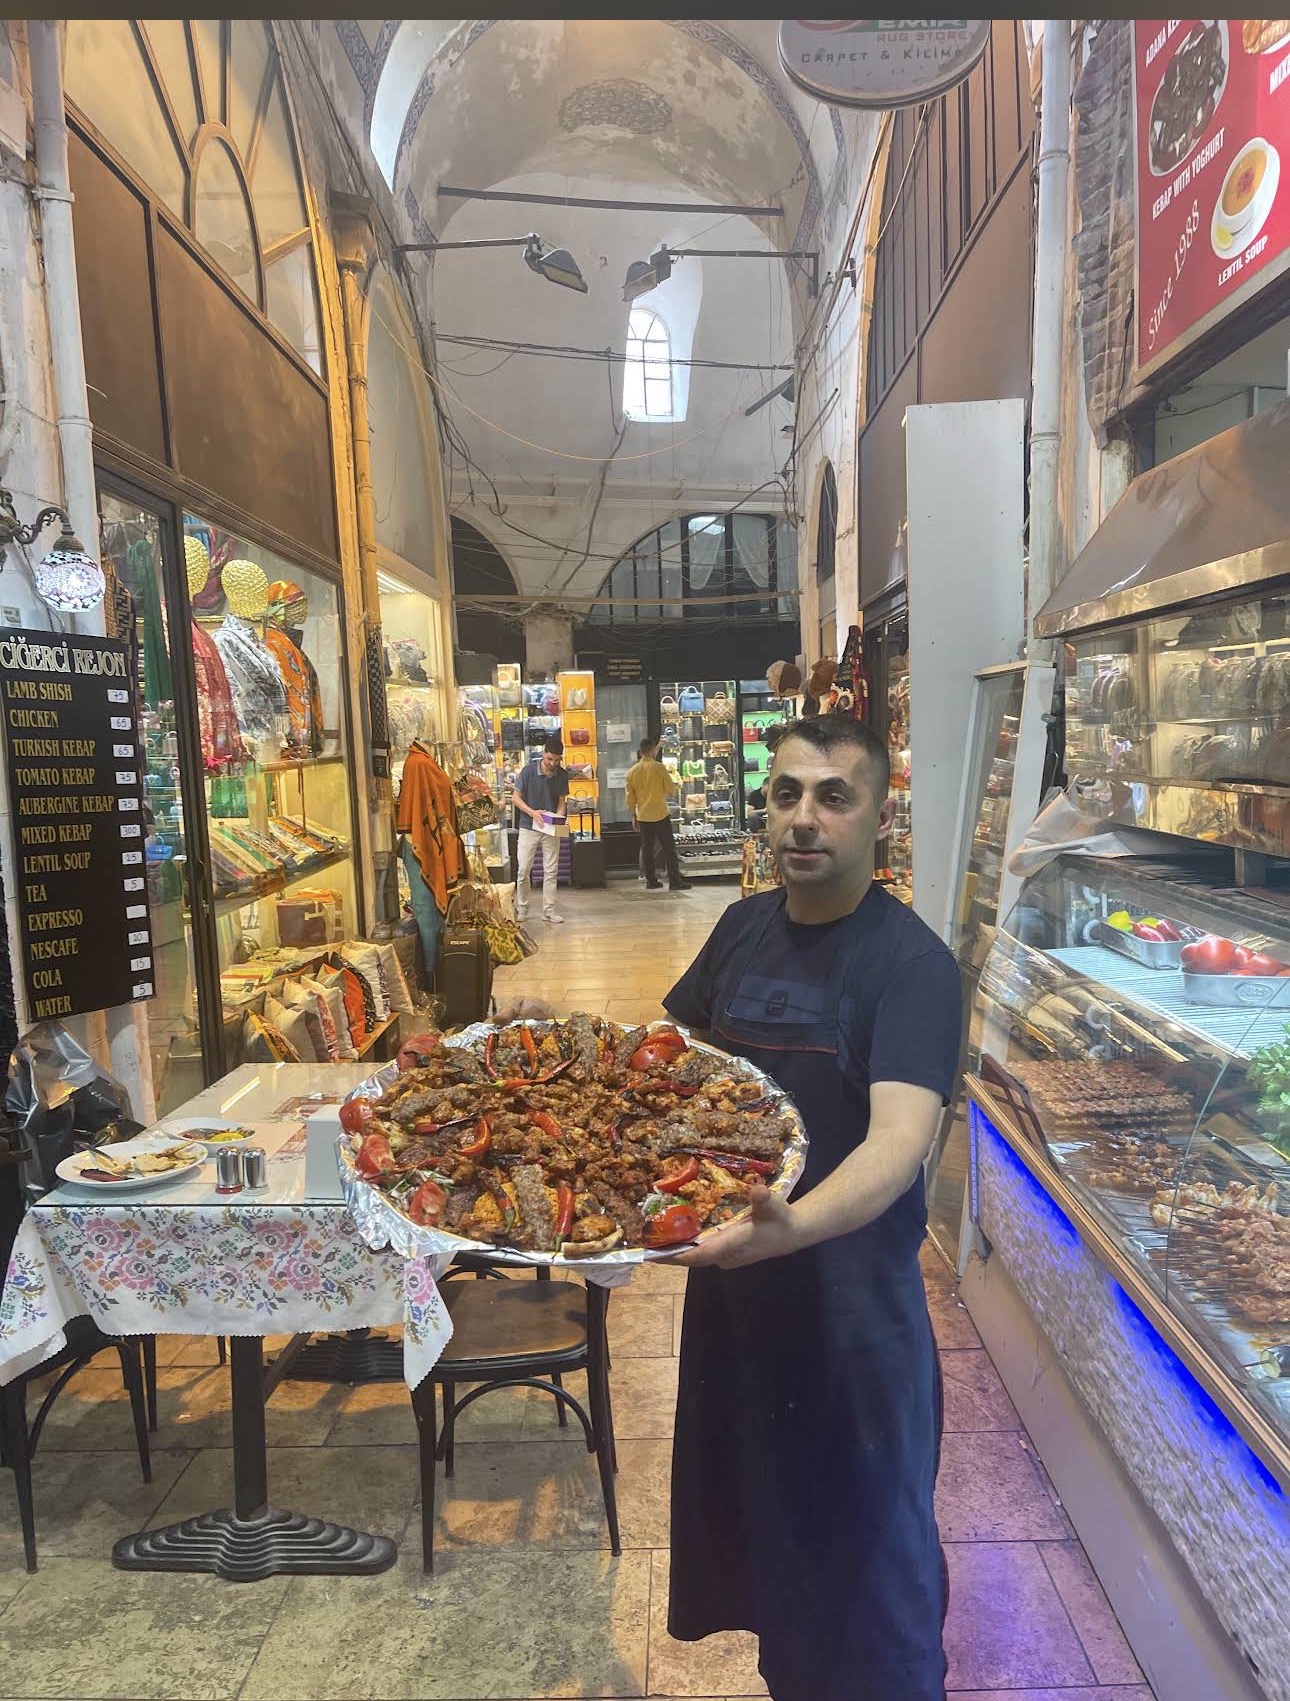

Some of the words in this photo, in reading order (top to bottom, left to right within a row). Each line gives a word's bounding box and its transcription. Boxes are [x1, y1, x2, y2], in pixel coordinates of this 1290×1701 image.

[881, 50, 890, 60] &
[1152, 185, 1173, 221] KEBAP
[1173, 164, 1191, 198] WITH
[1191, 126, 1225, 178] YOGHURT
[1218, 256, 1244, 287] LENTIL
[1244, 234, 1268, 264] SOUP
[1148, 276, 1174, 351] Since
[1174, 198, 1200, 282] 1988
[72, 648, 127, 677] REJON
[6, 680, 38, 699] LAMB
[39, 682, 73, 701] SHISH
[112, 690, 124, 701] 75
[9, 709, 59, 728] CHICKEN
[116, 718, 127, 728] 65
[12, 739, 60, 757] TURKISH
[62, 740, 96, 757] KEBAP
[118, 746, 129, 756] 65
[15, 767, 60, 786] TOMATO
[62, 767, 96, 785] KEBAP
[119, 773, 132, 783] 75
[19, 796, 80, 816] AUBERGINE
[82, 795, 115, 813] KEBAP
[121, 800, 134, 810] 75
[21, 825, 57, 845] MIXED
[58, 823, 93, 842] KEBAP
[23, 854, 62, 874] LENTIL
[63, 851, 91, 871] SOUP
[25, 884, 48, 903] TEA
[131, 879, 137, 890] 5
[27, 908, 84, 932] EXPRESSO
[30, 937, 79, 961] NESCAFE
[32, 968, 63, 990] COLA
[139, 985, 146, 996] 5
[35, 995, 73, 1018] WATER
